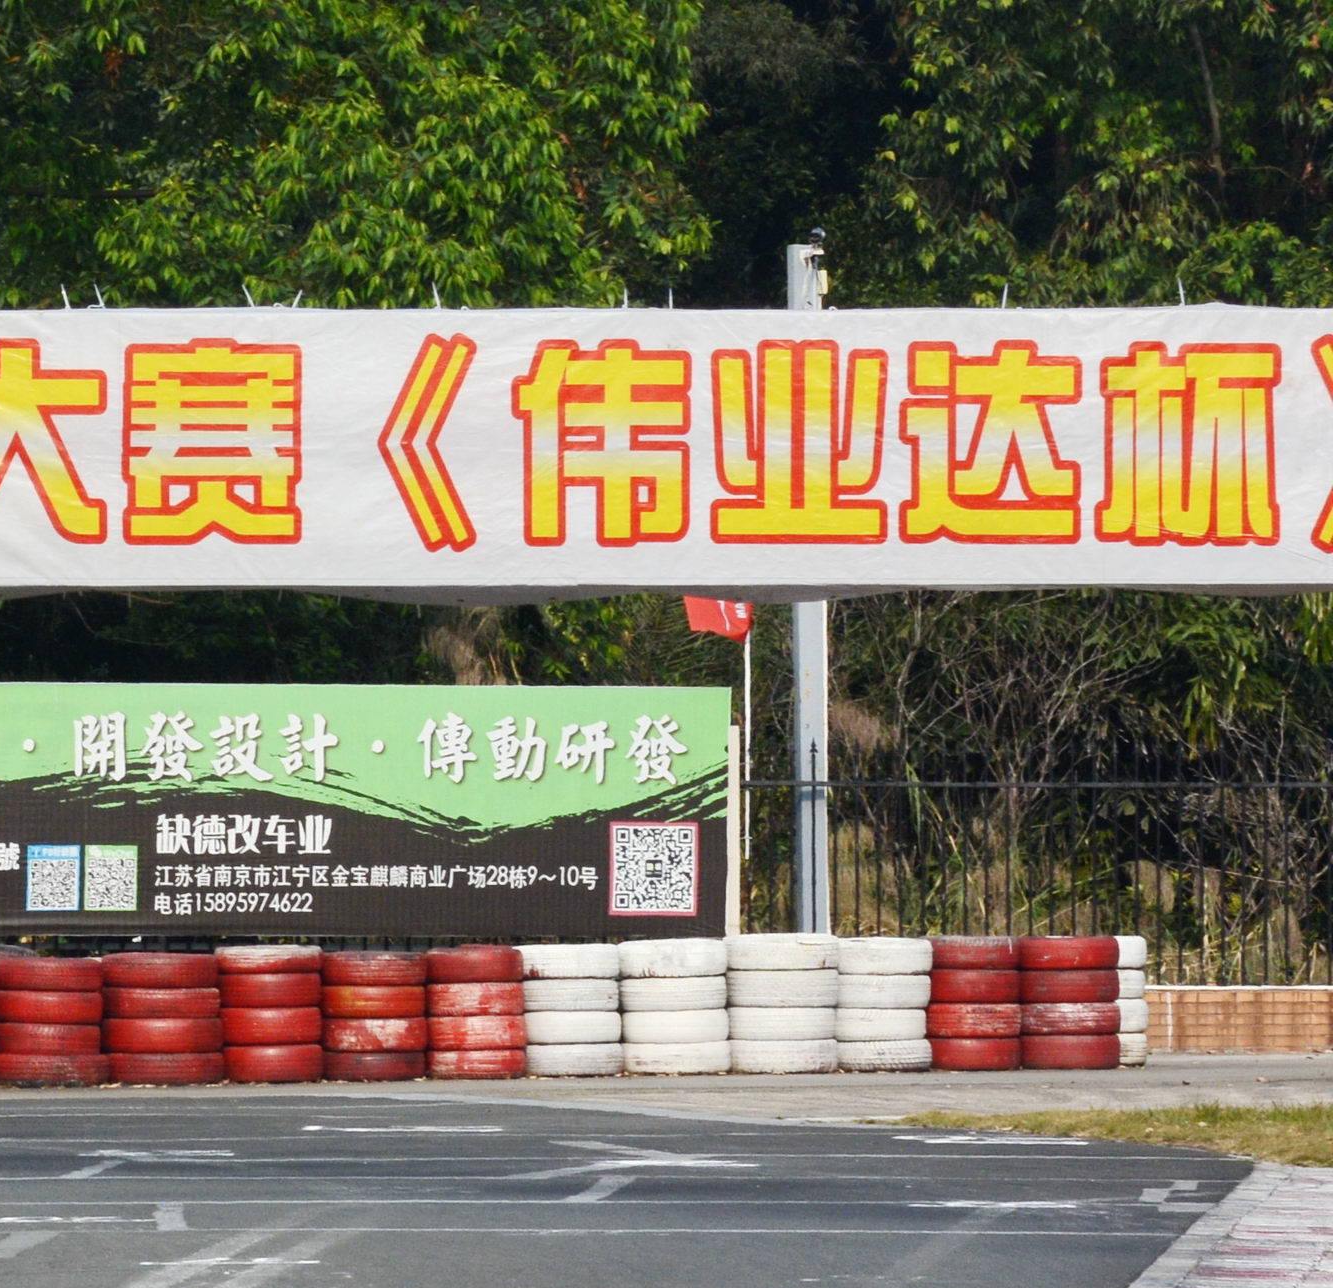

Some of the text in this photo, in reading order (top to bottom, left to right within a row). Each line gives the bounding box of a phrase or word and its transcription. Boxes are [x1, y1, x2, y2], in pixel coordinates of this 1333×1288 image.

[73, 712, 340, 783] 開發設計
[416, 714, 690, 786] 傳動研發
[156, 813, 332, 855] 缺德改车业
[154, 892, 313, 914] 电话15895974622
